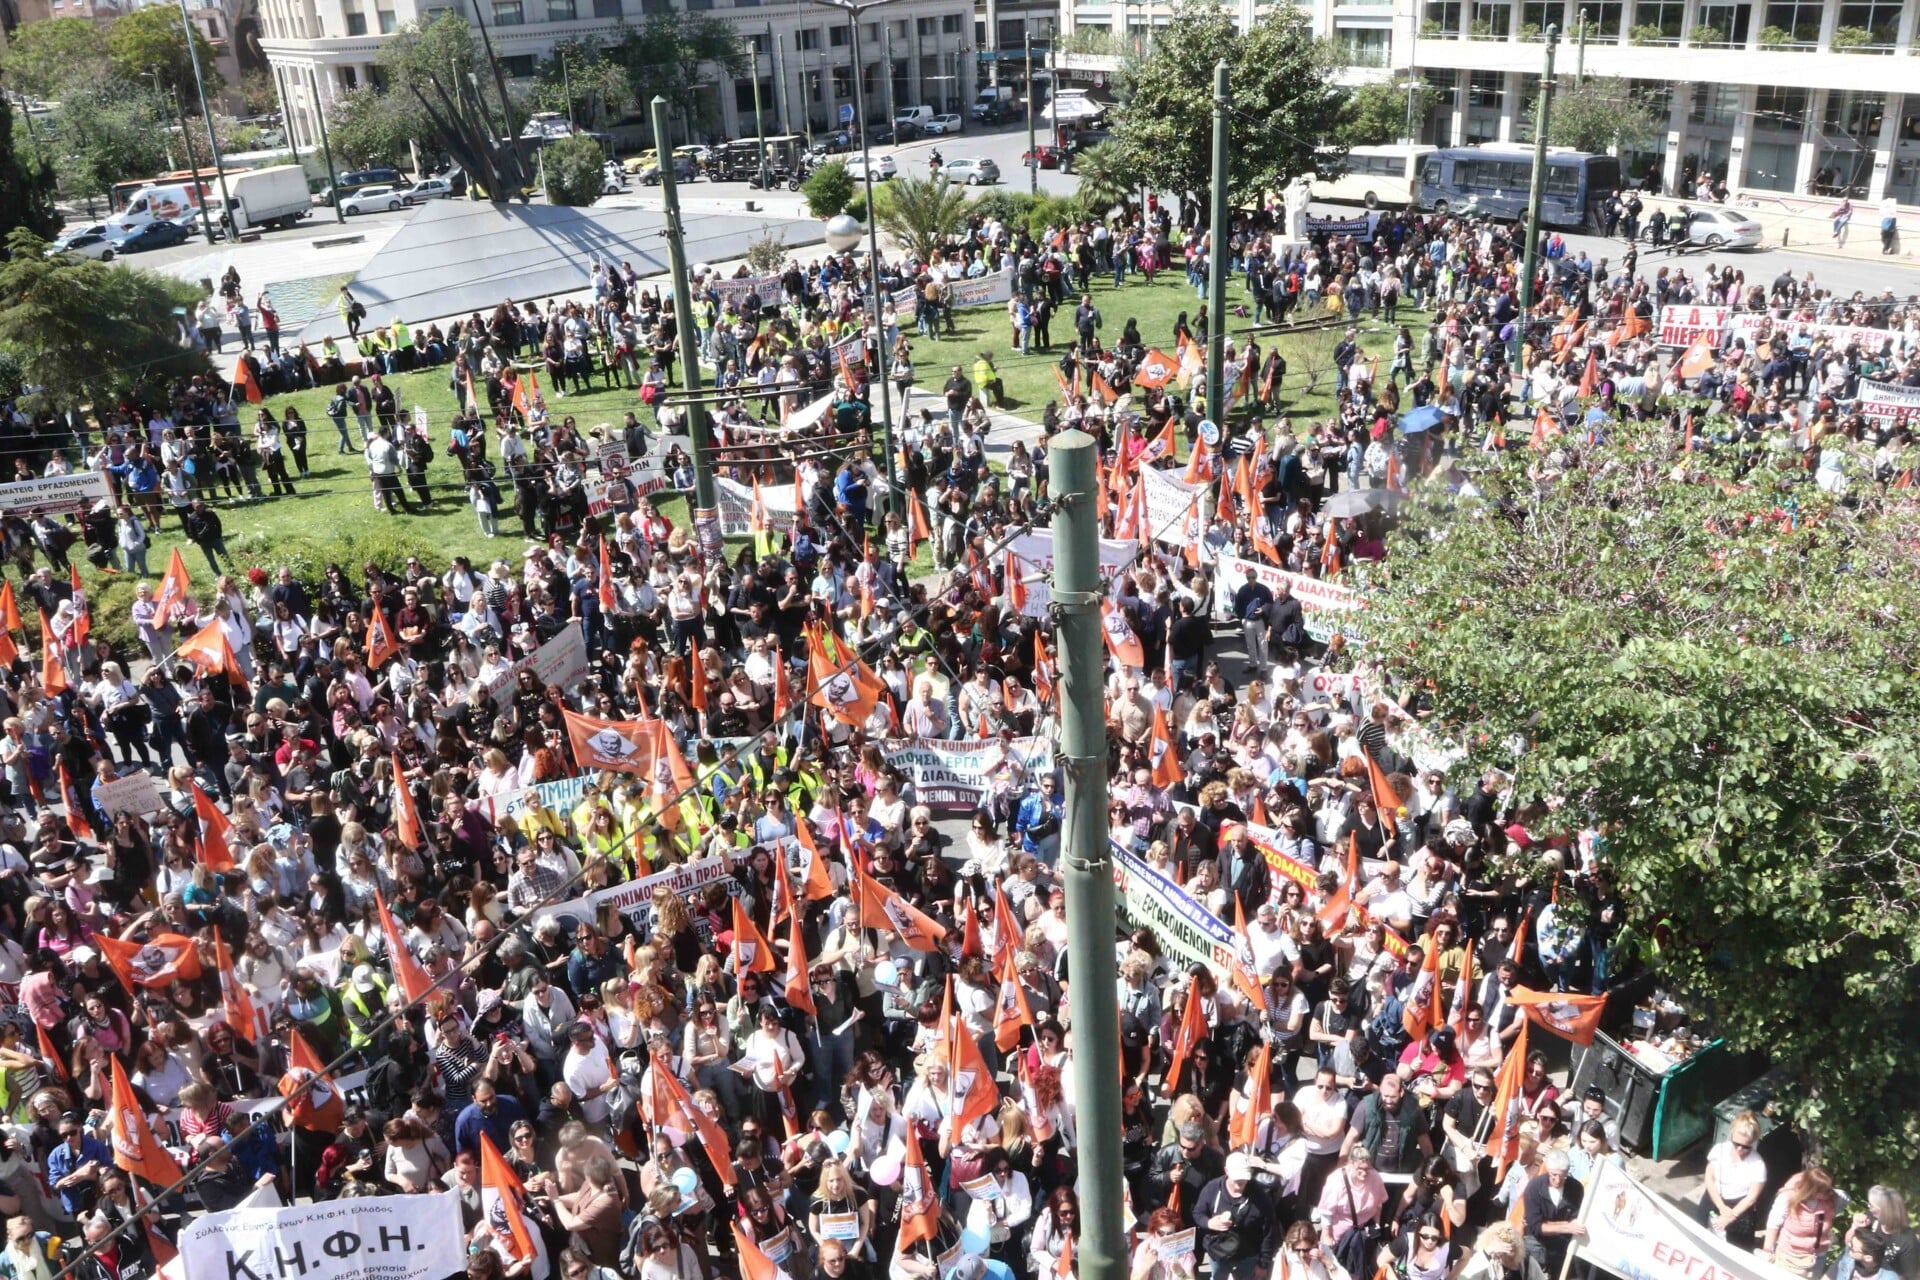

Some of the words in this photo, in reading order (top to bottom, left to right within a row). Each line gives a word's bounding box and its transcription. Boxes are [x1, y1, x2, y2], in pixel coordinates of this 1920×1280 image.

[38, 477, 100, 491] ΕΡΓΑΖΟΜΕΝΩΝ
[1142, 893, 1212, 959] ΕΡΓΑΖΟΜΕΝΩΝ
[1213, 944, 1234, 972] ΕΣΠ
[306, 1209, 349, 1223] Κ.Η.Φ.Η.
[226, 1225, 426, 1280] Κ.Η.Φ.Η.
[1652, 1241, 1736, 1280] ΕΡΓΑ
